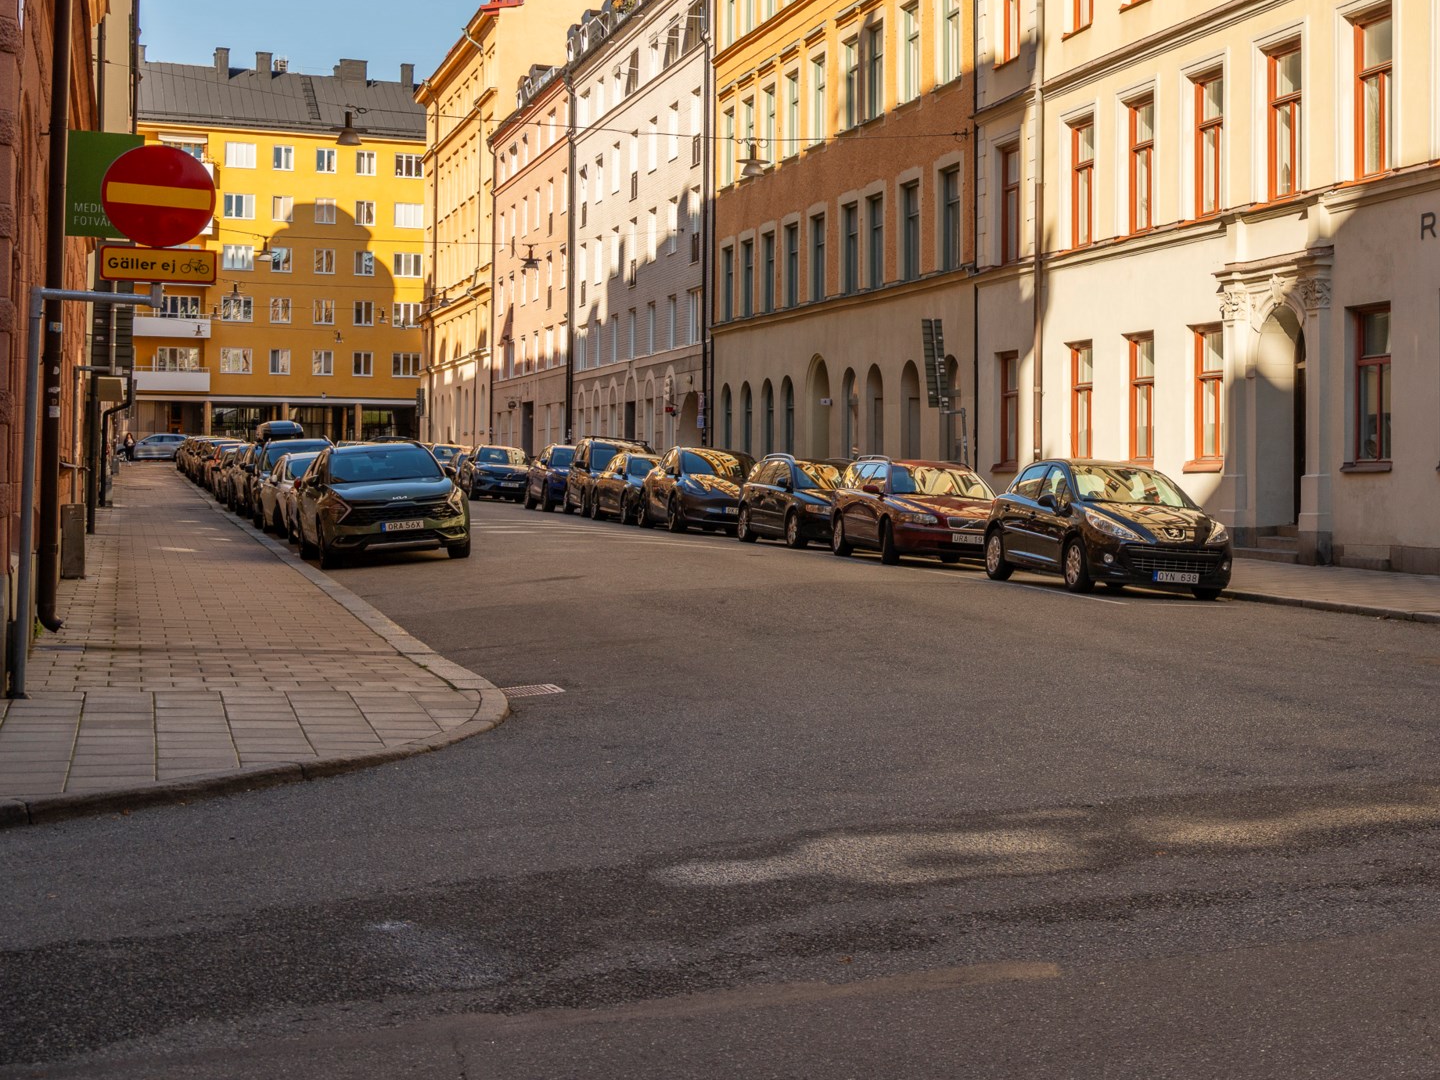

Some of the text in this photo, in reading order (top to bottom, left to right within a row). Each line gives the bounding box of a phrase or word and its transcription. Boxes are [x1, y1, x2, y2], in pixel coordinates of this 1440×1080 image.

[108, 257, 176, 274] Gäller ej
[405, 520, 420, 528] 56X
[954, 534, 968, 542] URA
[1158, 572, 1198, 582] OYN 638
